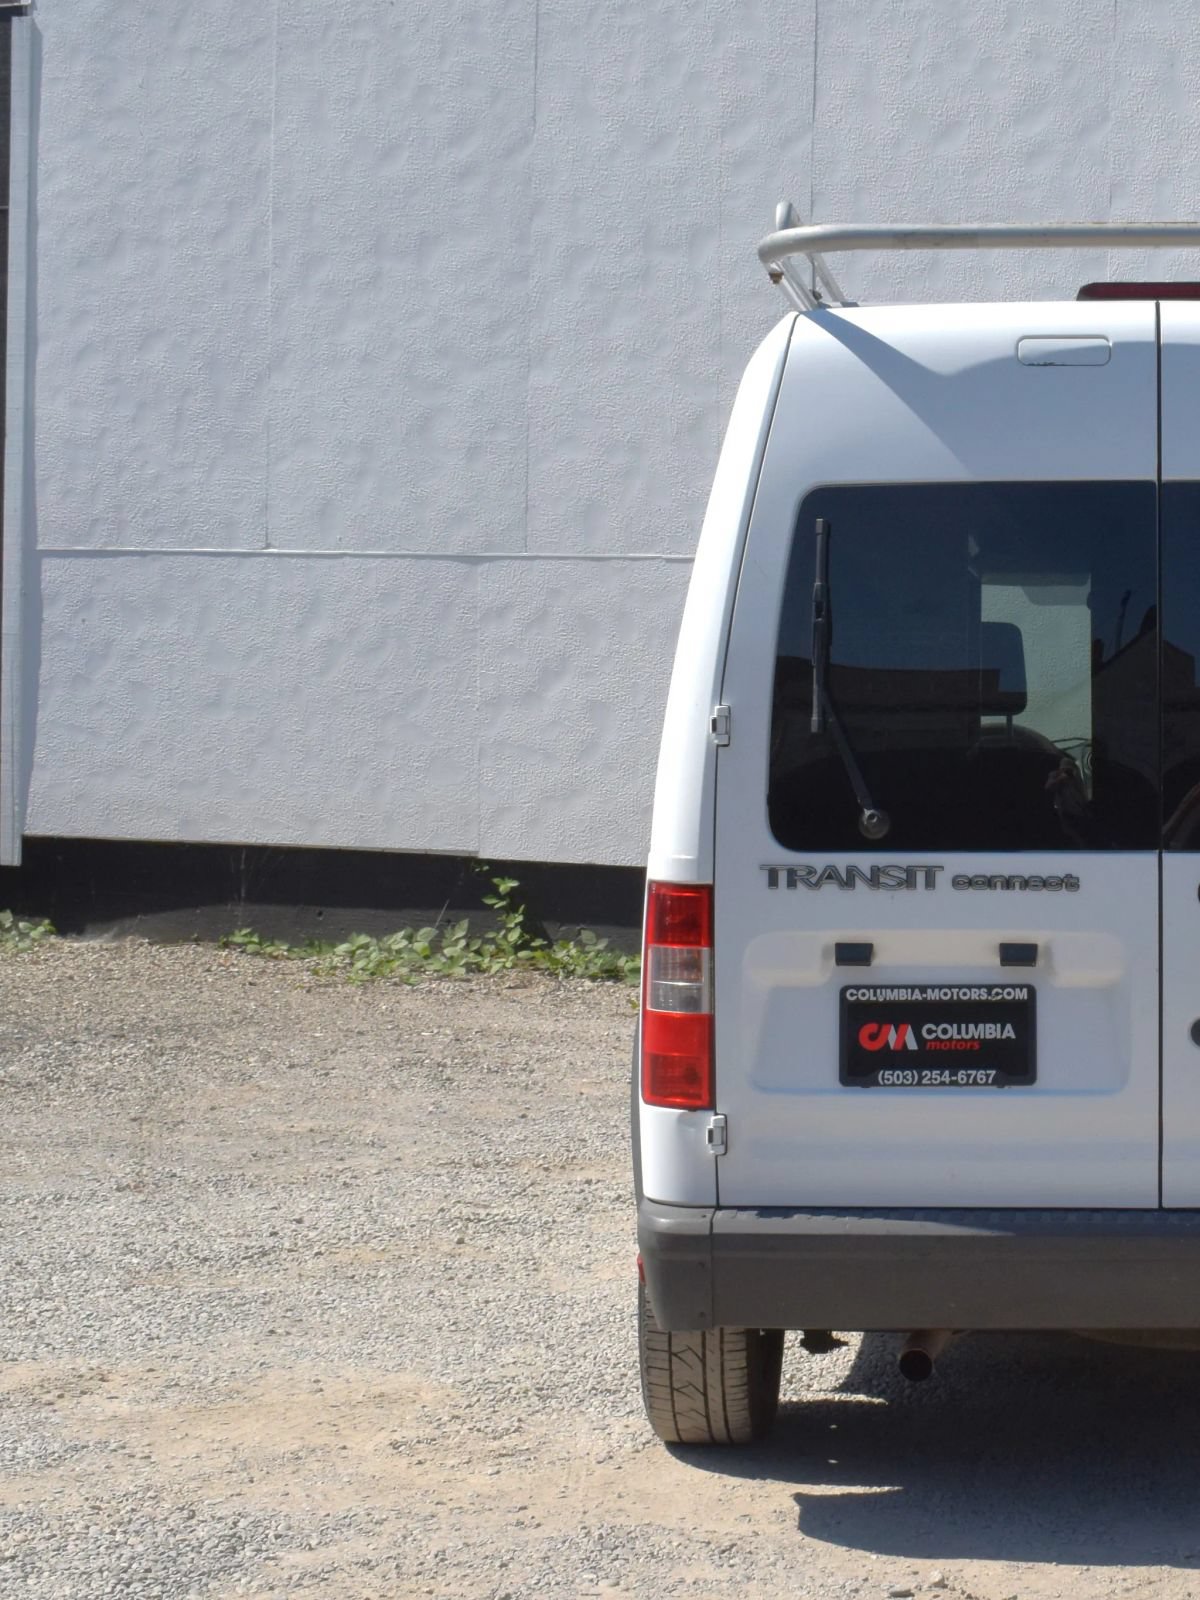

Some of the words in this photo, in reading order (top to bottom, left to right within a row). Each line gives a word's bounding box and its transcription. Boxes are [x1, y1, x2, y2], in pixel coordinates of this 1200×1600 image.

[759, 864, 944, 891] TRANSIT
[951, 873, 1080, 892] connect
[845, 988, 1028, 1002] COLUMBIA-MOTORS.COM
[921, 1023, 1016, 1040] COLUMBIA
[926, 1039, 981, 1051] motors
[878, 1070, 919, 1086] (503)
[921, 1070, 996, 1085] 254-6767
